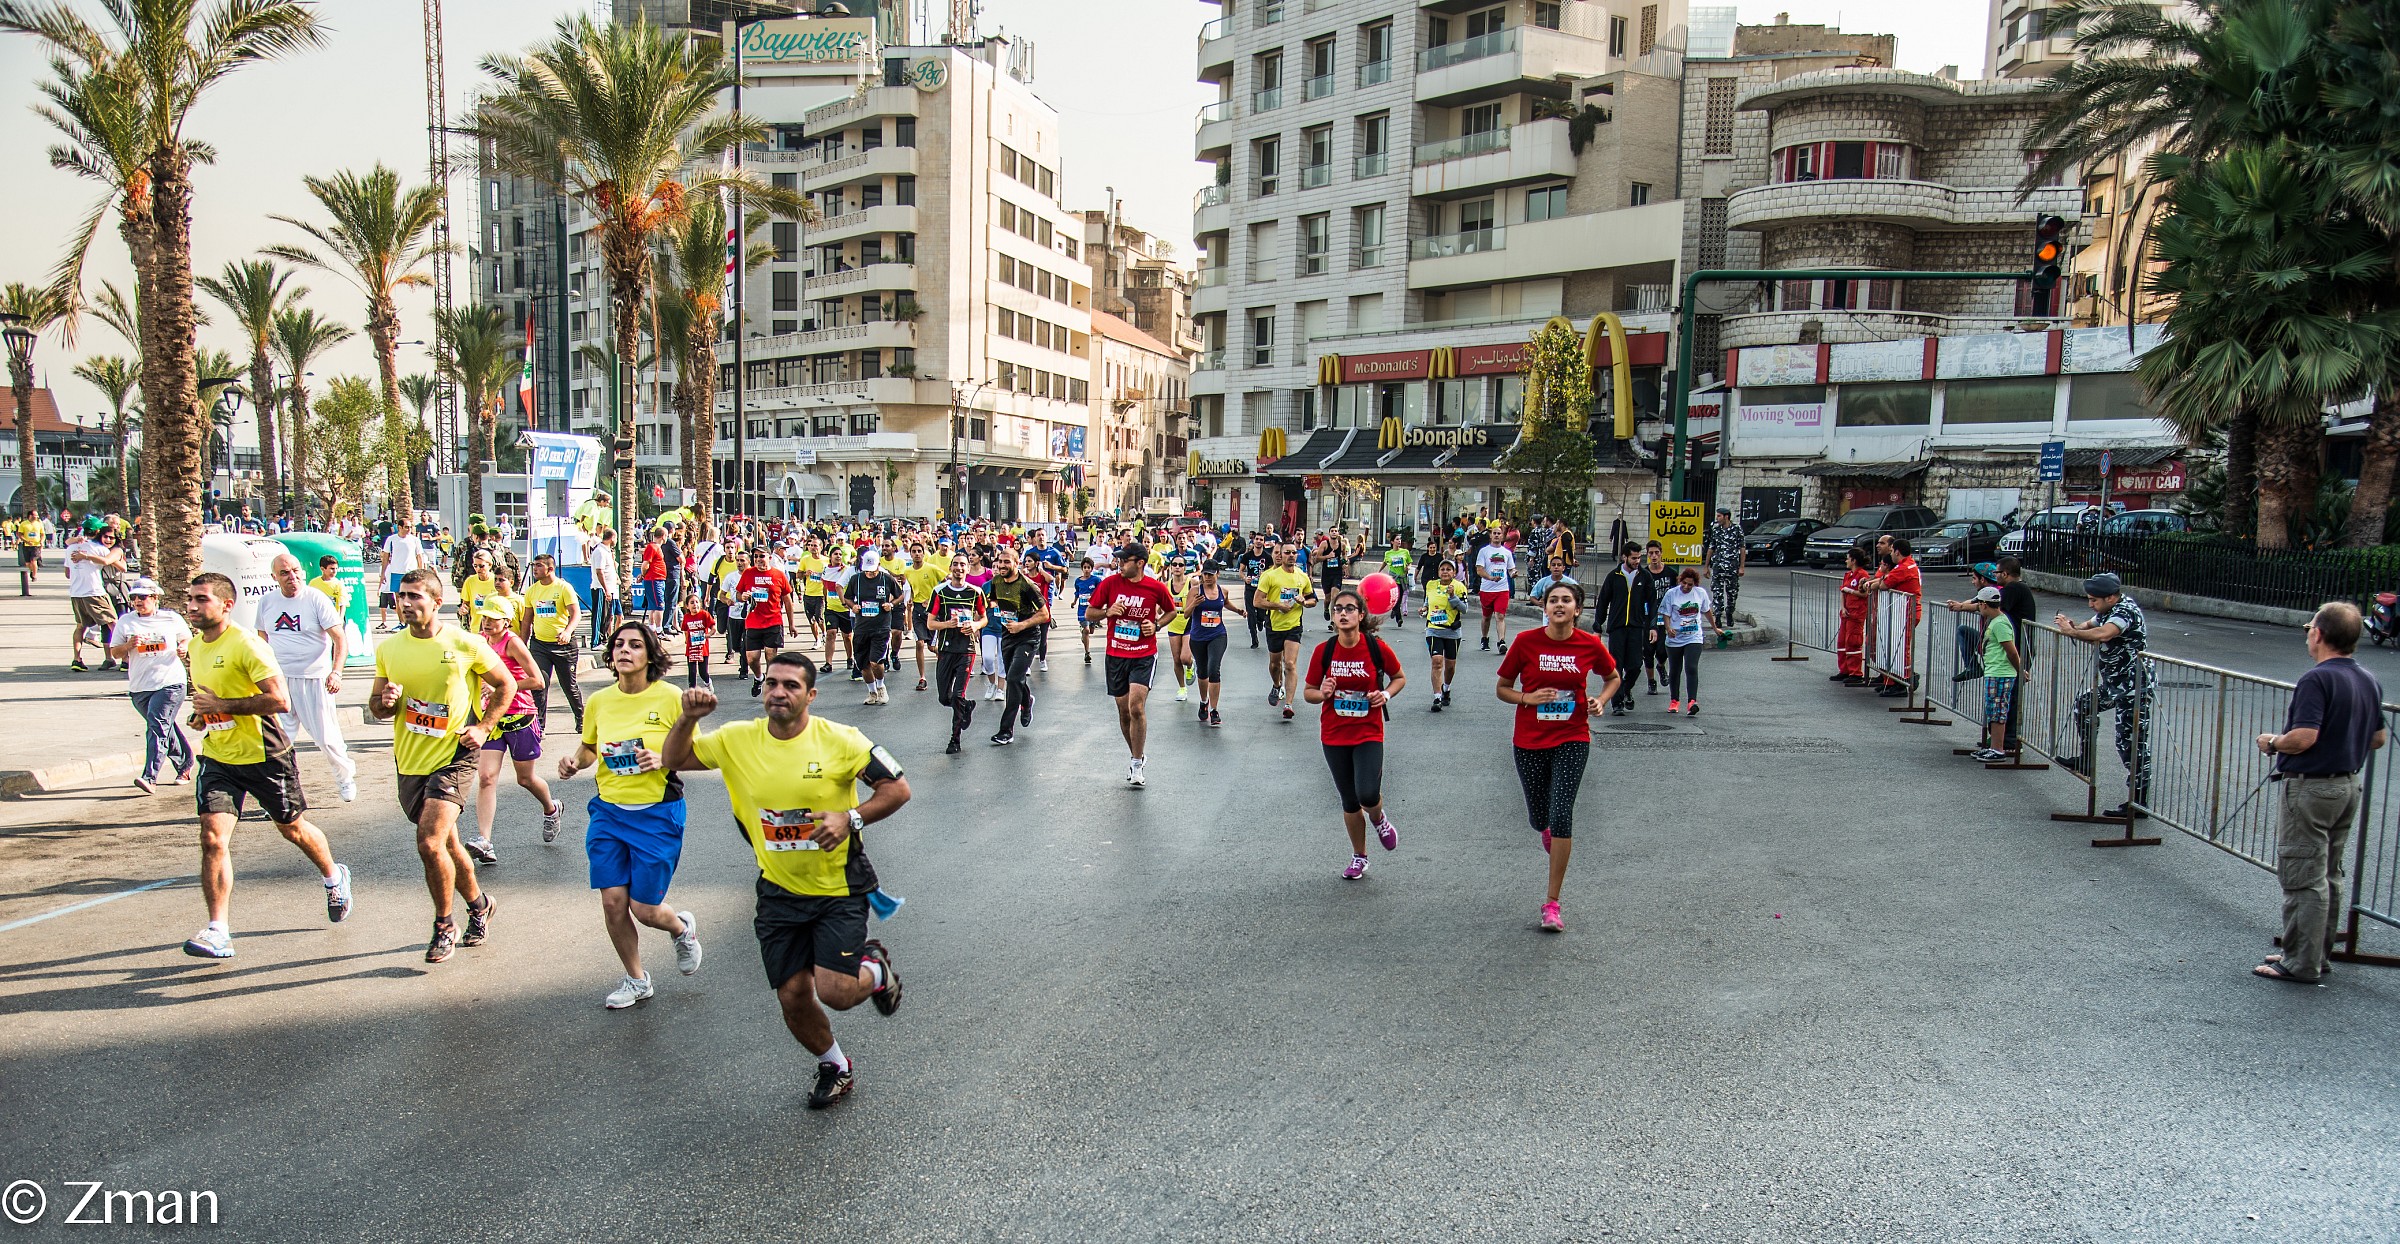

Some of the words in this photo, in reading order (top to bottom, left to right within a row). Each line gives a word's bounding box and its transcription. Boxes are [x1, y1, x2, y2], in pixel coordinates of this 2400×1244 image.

[731, 21, 868, 60] Bayview
[805, 50, 852, 60] HOTEL
[1354, 357, 1419, 374] McDonald's
[1740, 408, 1784, 424] Moving
[1787, 406, 1817, 421] Soon
[1378, 417, 1488, 450] McDonald's
[1188, 450, 1244, 477] McDonald's
[2117, 476, 2122, 489] I
[2134, 476, 2154, 489] MY
[2156, 475, 2181, 489] CAR
[1655, 505, 1700, 519] الطريق
[1656, 521, 1697, 538] مقفل
[1115, 594, 1146, 608] RUN
[1128, 607, 1150, 619] BLF
[145, 643, 160, 652] 484
[1340, 701, 1363, 711] 6492
[1544, 702, 1569, 713] 6568
[415, 714, 436, 728] 661
[775, 825, 802, 840] 682
